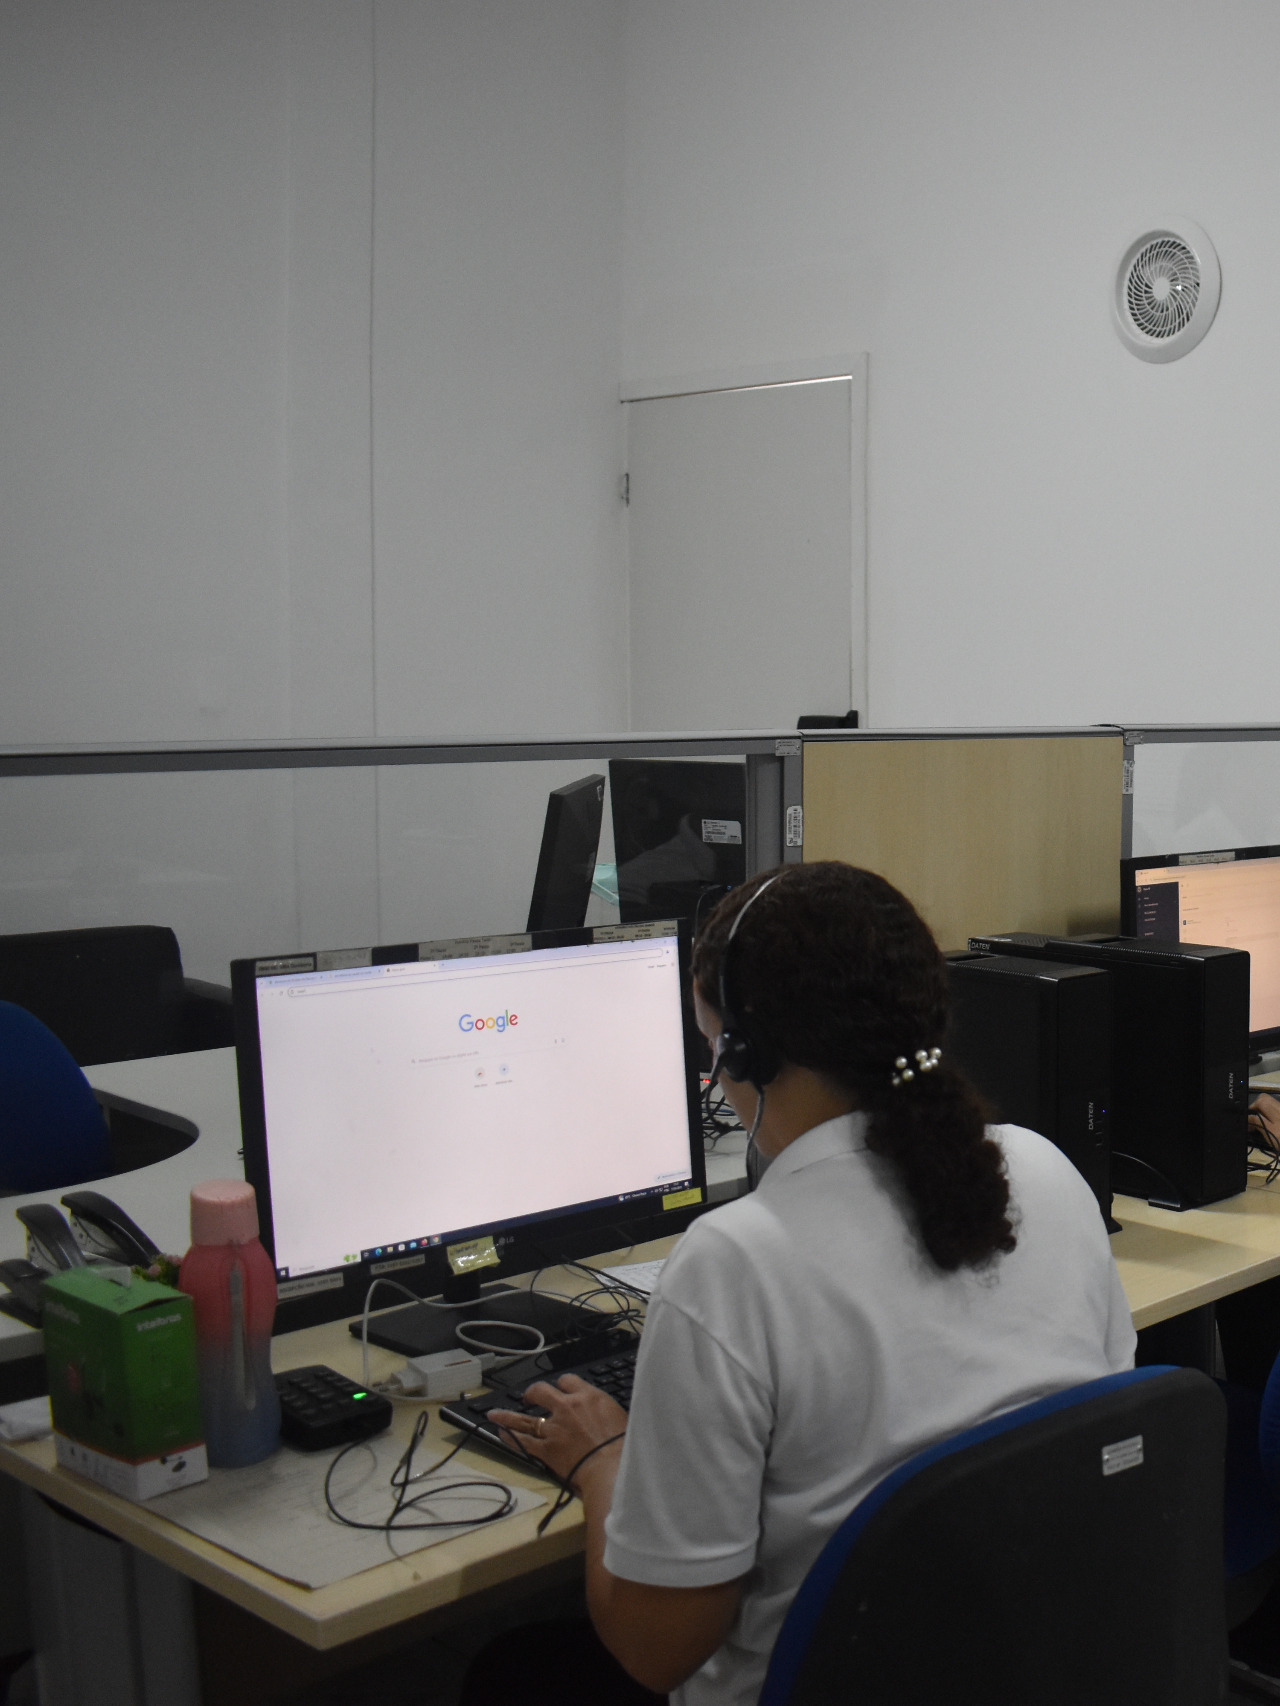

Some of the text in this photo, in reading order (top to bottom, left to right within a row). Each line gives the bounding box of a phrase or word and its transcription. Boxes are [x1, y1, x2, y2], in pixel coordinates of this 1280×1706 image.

[971, 941, 991, 950] DATEN
[458, 1009, 519, 1033] Google
[506, 1236, 515, 1244] LG
